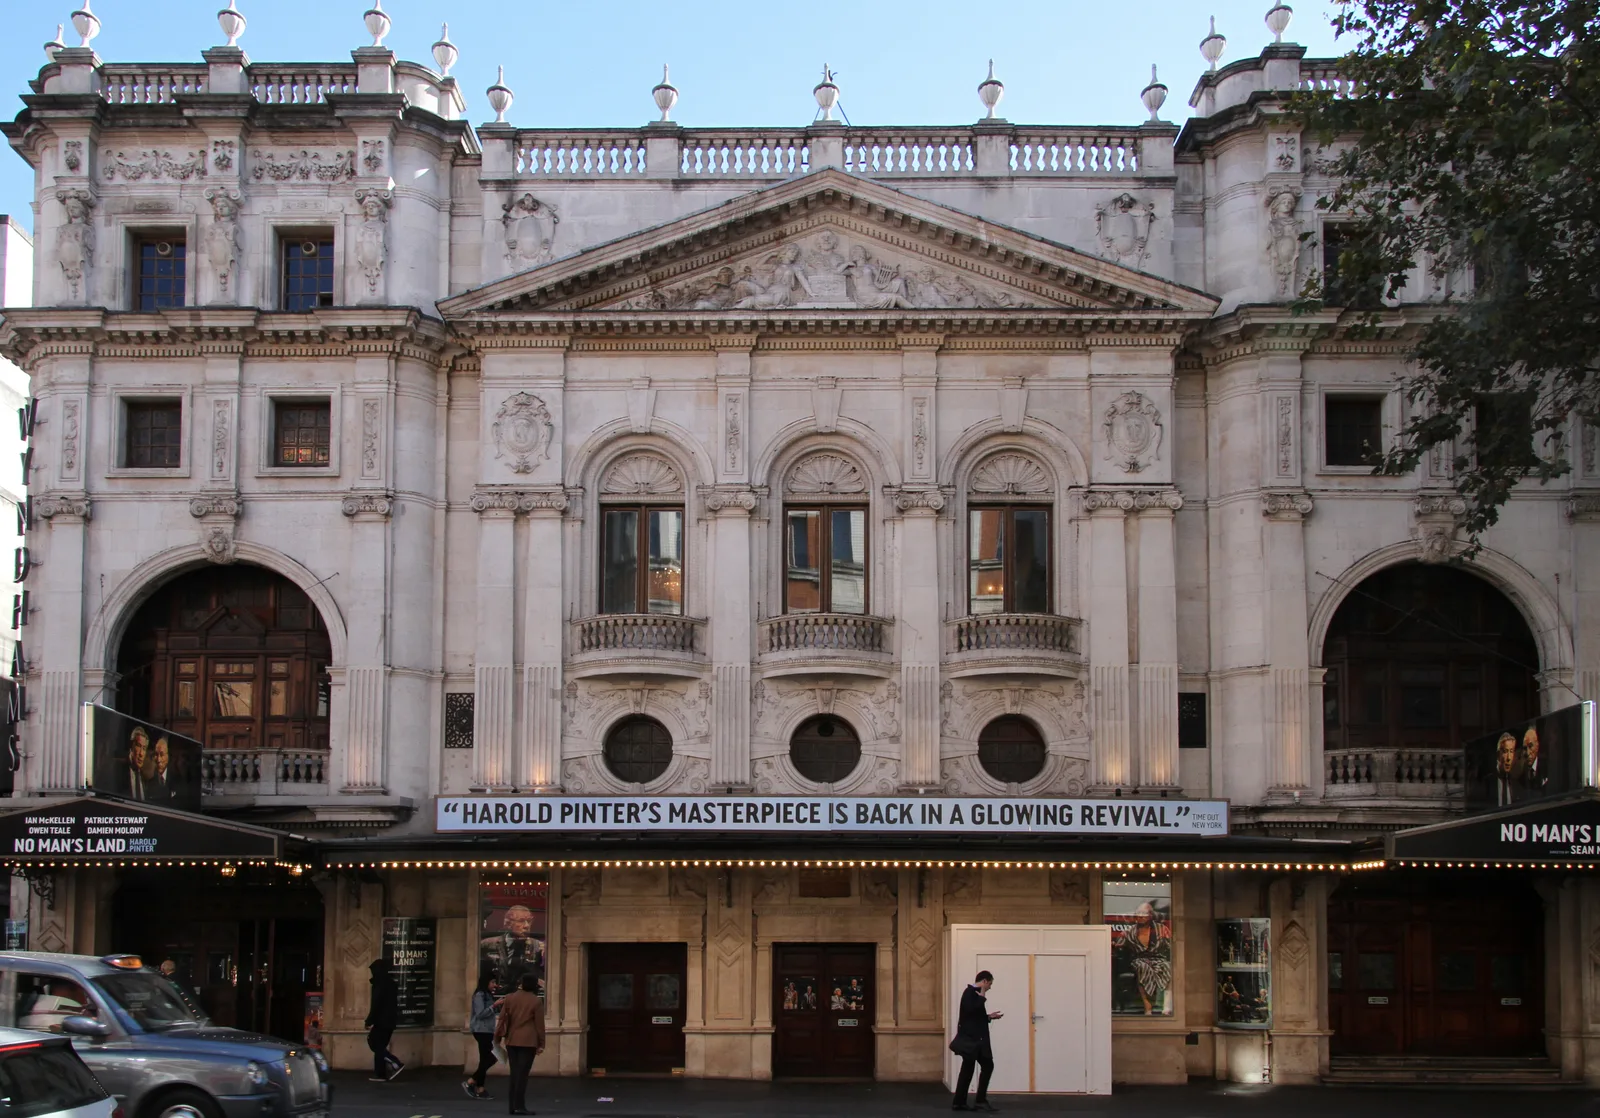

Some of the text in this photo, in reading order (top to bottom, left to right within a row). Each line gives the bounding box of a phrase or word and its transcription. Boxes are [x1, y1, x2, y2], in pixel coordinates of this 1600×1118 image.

[560, 802, 662, 824] PINTER’S
[668, 802, 821, 824] MASTERPIECE
[828, 802, 849, 825] IS
[855, 802, 914, 825] BACK
[921, 803, 942, 825] IN
[949, 803, 965, 825] A
[971, 803, 1074, 826] GLOWING
[1192, 813, 1219, 821] TIME OUT
[25, 816, 76, 825] IAN McKELLEN
[84, 816, 149, 825] PATRICK STEWART
[1192, 821, 1223, 829] NEW YORK
[28, 826, 71, 835] OWEN TEALE
[87, 826, 145, 835] DAMIEN MOLONY
[1500, 823, 1527, 843] NO
[1531, 823, 1592, 844] MAN’S
[14, 837, 126, 853] NO MAN’S LAND
[129, 838, 158, 846] HAROLD
[129, 845, 155, 853] PINTER
[1570, 845, 1595, 855] SEAN
[393, 950, 405, 958] NO
[393, 958, 415, 966] LAND
